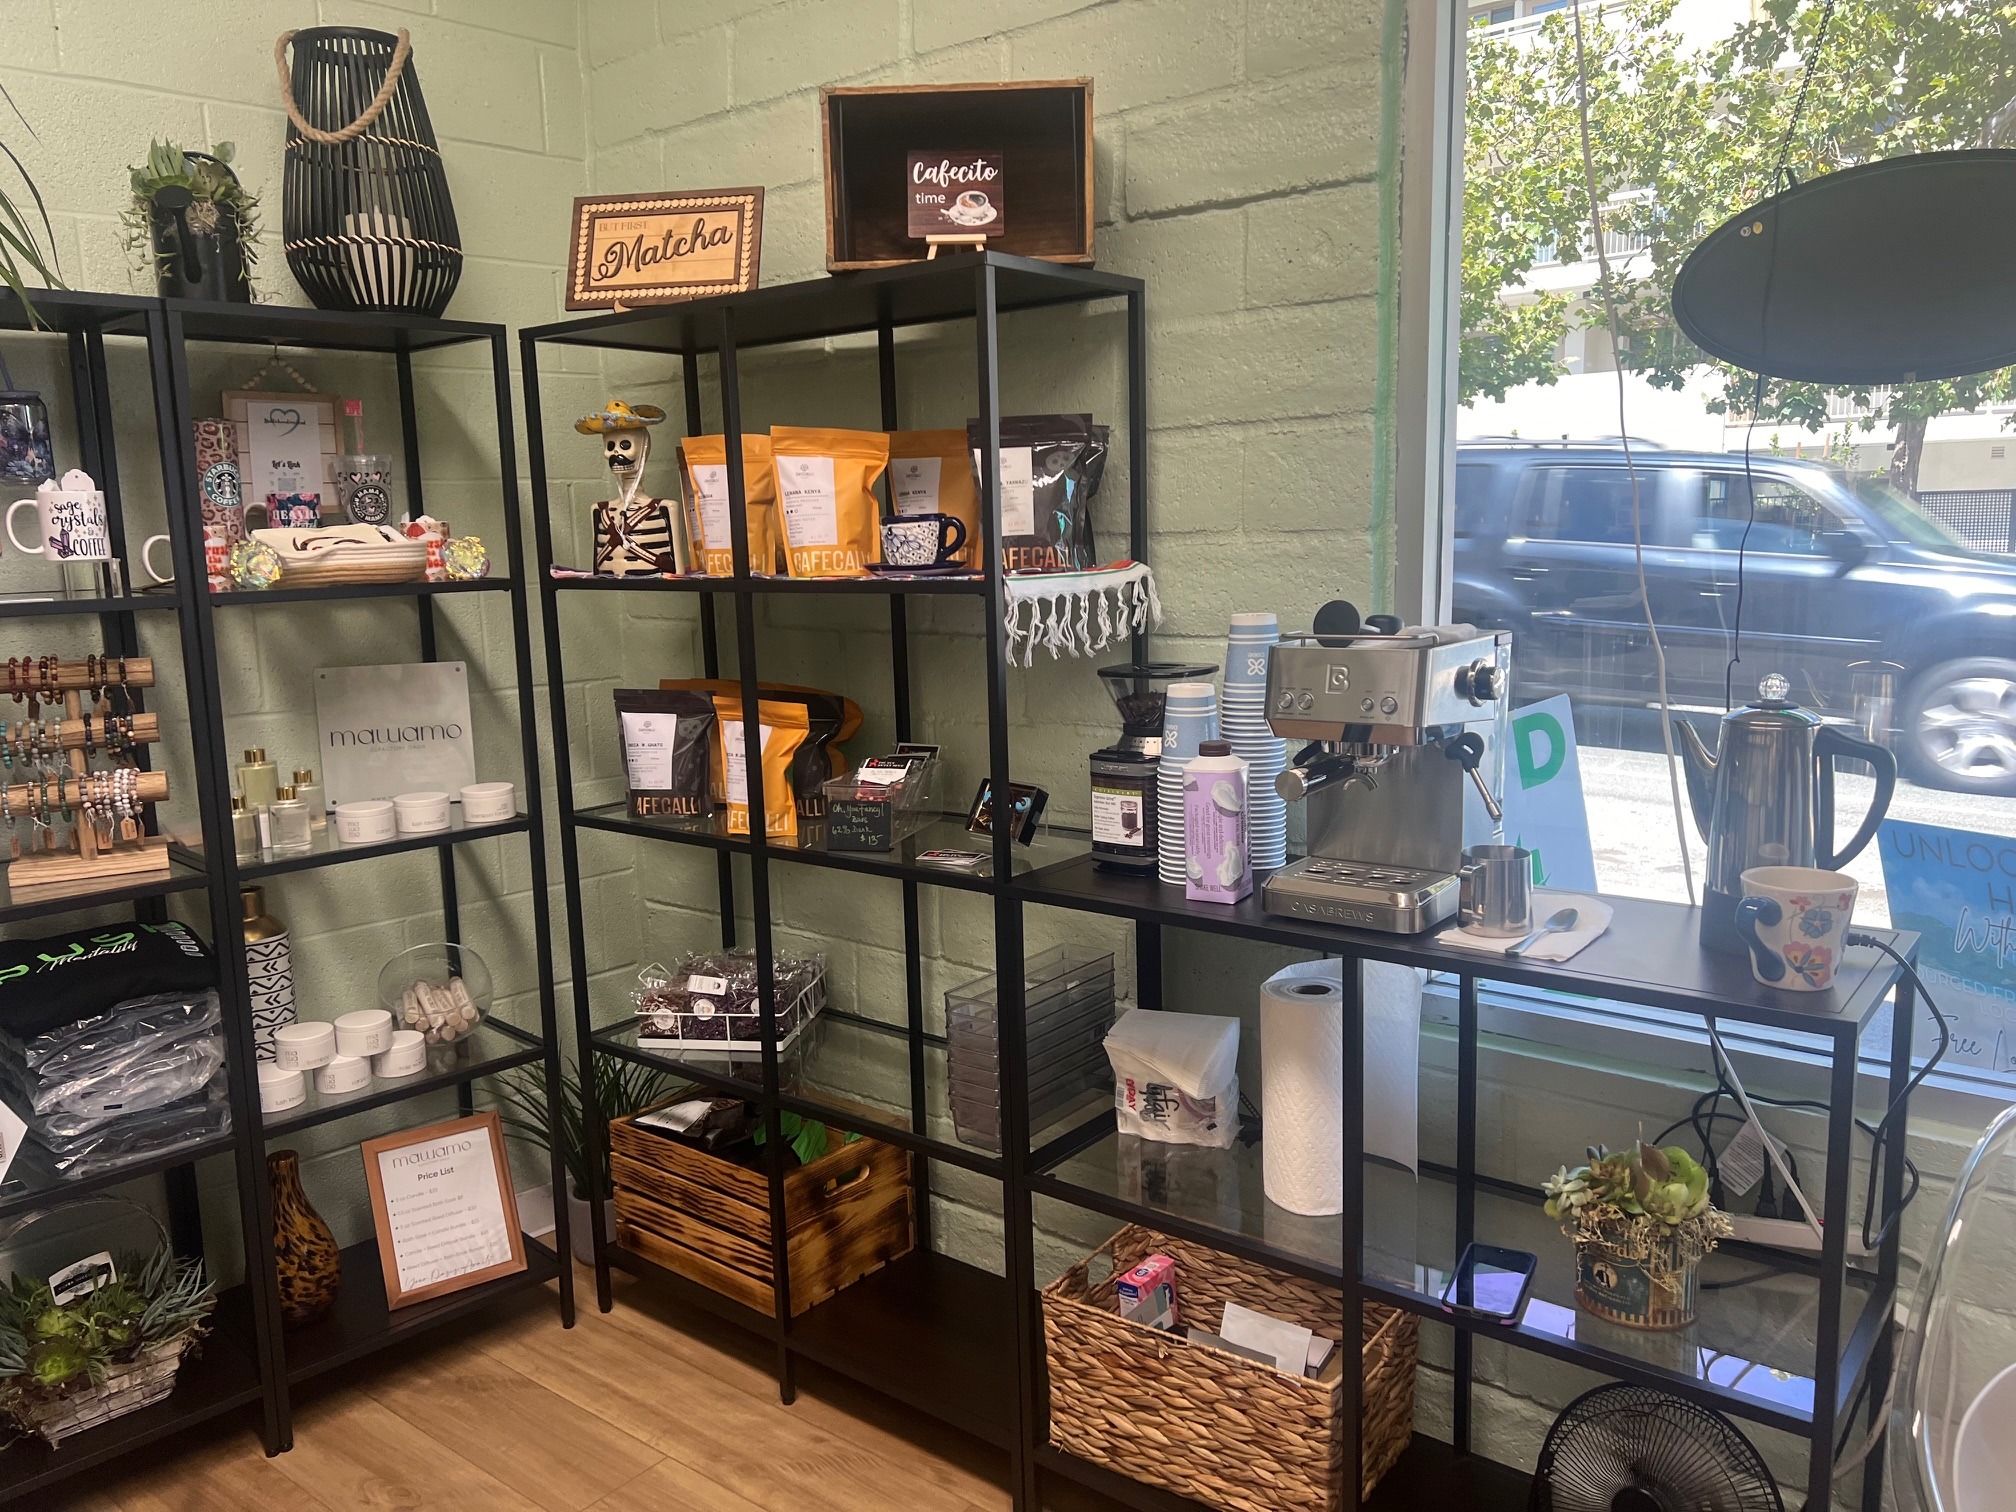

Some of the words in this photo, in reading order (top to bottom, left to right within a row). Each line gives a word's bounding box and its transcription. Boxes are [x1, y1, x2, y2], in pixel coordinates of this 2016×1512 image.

[913, 158, 998, 188] Cafecito
[915, 192, 946, 204] time
[599, 222, 618, 232] BUT
[620, 220, 648, 230] FIRST
[592, 217, 733, 282] Matcha
[51, 507, 103, 532] crystals
[73, 538, 106, 557] COFFEE
[330, 722, 463, 747] mawamo
[832, 826, 851, 835] 62%
[392, 1140, 472, 1169] mawamo
[417, 1170, 439, 1182] Price
[440, 1166, 455, 1176] List
